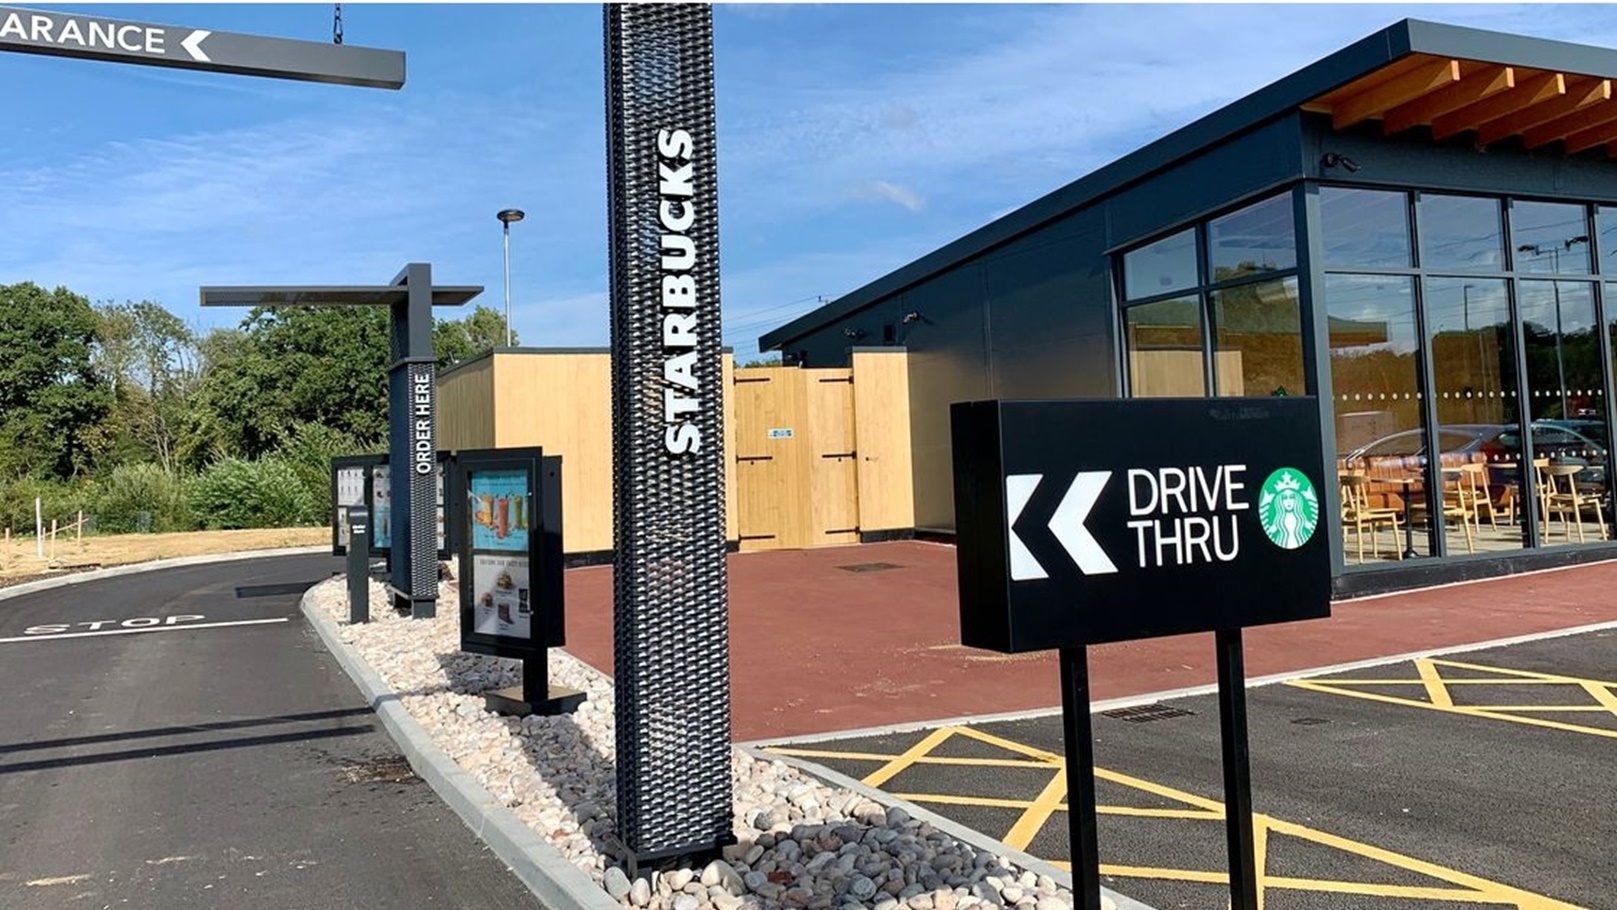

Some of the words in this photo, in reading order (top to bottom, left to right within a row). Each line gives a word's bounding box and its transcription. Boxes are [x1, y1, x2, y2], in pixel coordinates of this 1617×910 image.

[0, 13, 165, 54] ARANCE
[658, 128, 701, 456] STARBUCKS
[414, 373, 431, 416] HERE
[415, 420, 432, 474] ORDER
[1127, 464, 1250, 516] DRIVE
[1127, 514, 1240, 568] THRU
[24, 614, 206, 635] STOP
